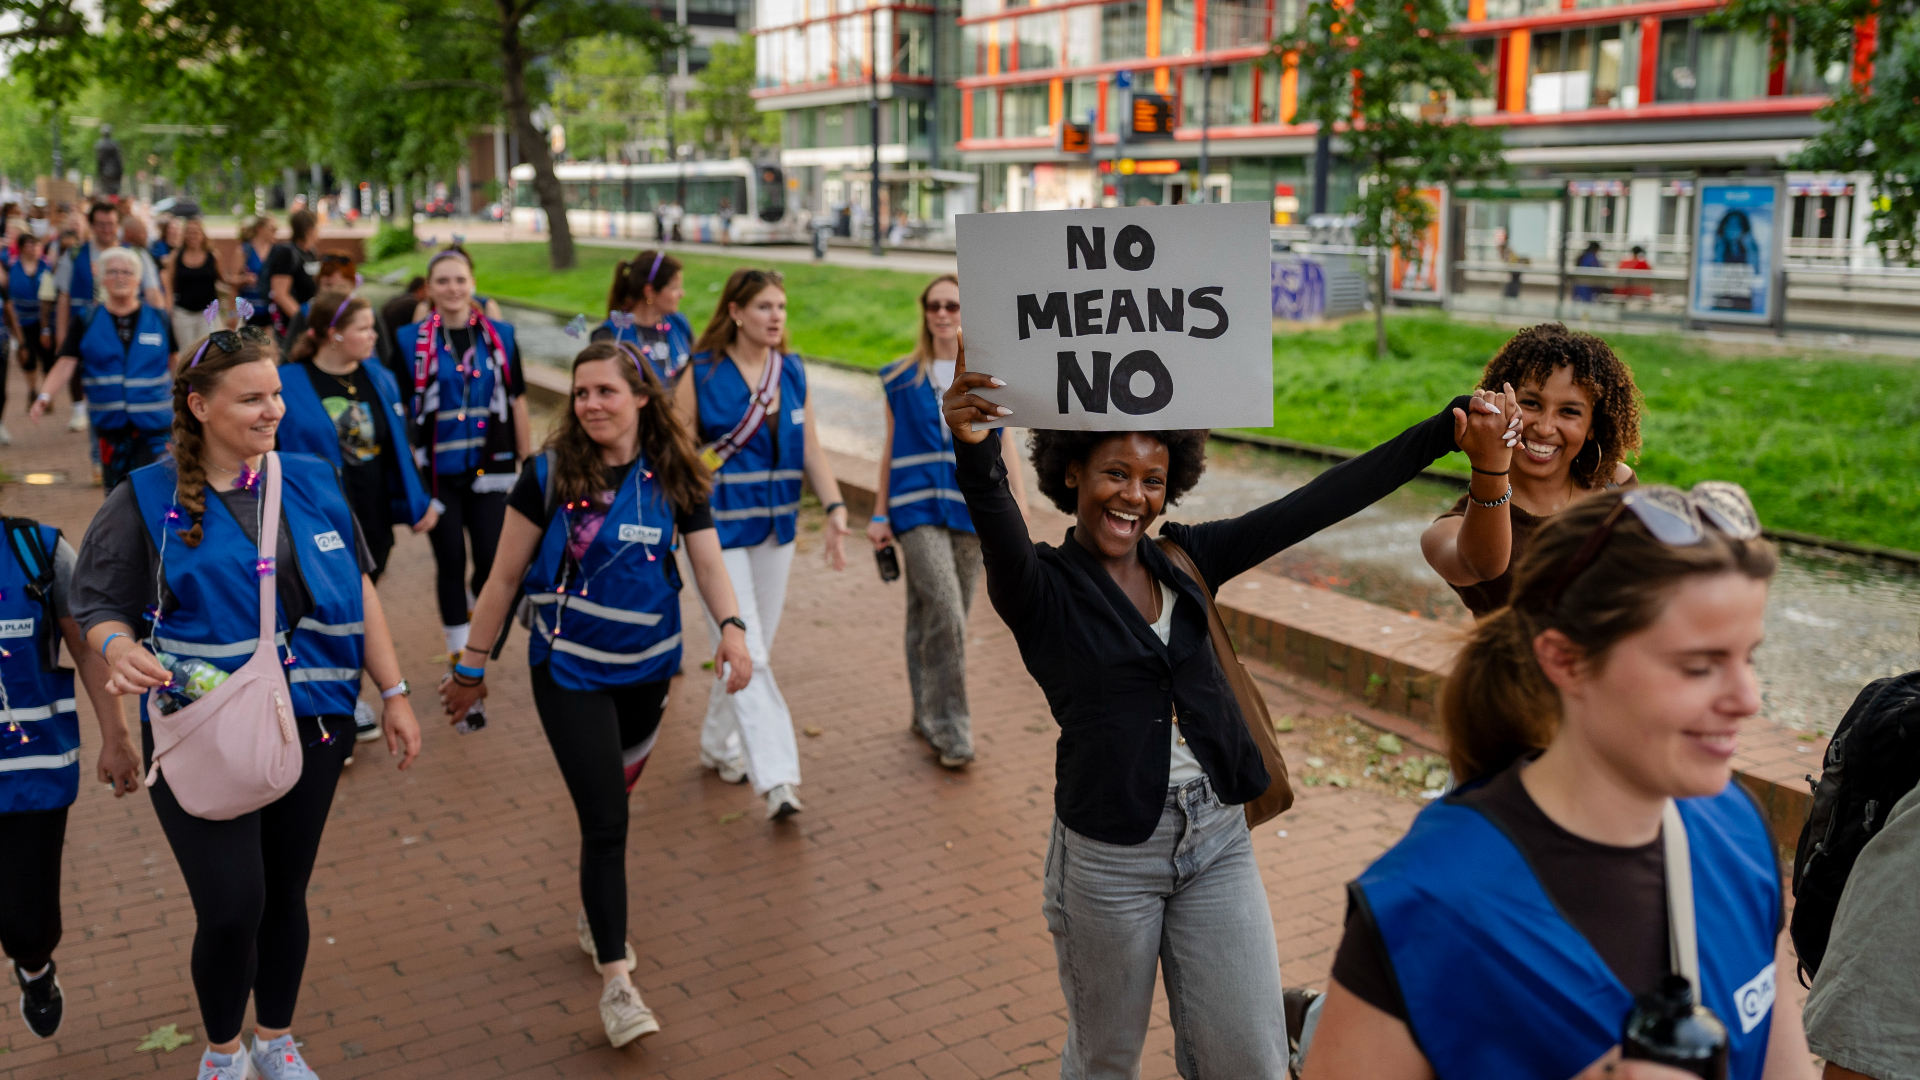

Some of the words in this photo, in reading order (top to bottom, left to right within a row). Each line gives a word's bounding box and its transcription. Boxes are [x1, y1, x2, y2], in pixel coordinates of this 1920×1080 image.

[1067, 225, 1155, 271] NO
[1017, 287, 1229, 340] MEANS
[1057, 350, 1173, 415] NO
[5, 623, 31, 631] PLAN
